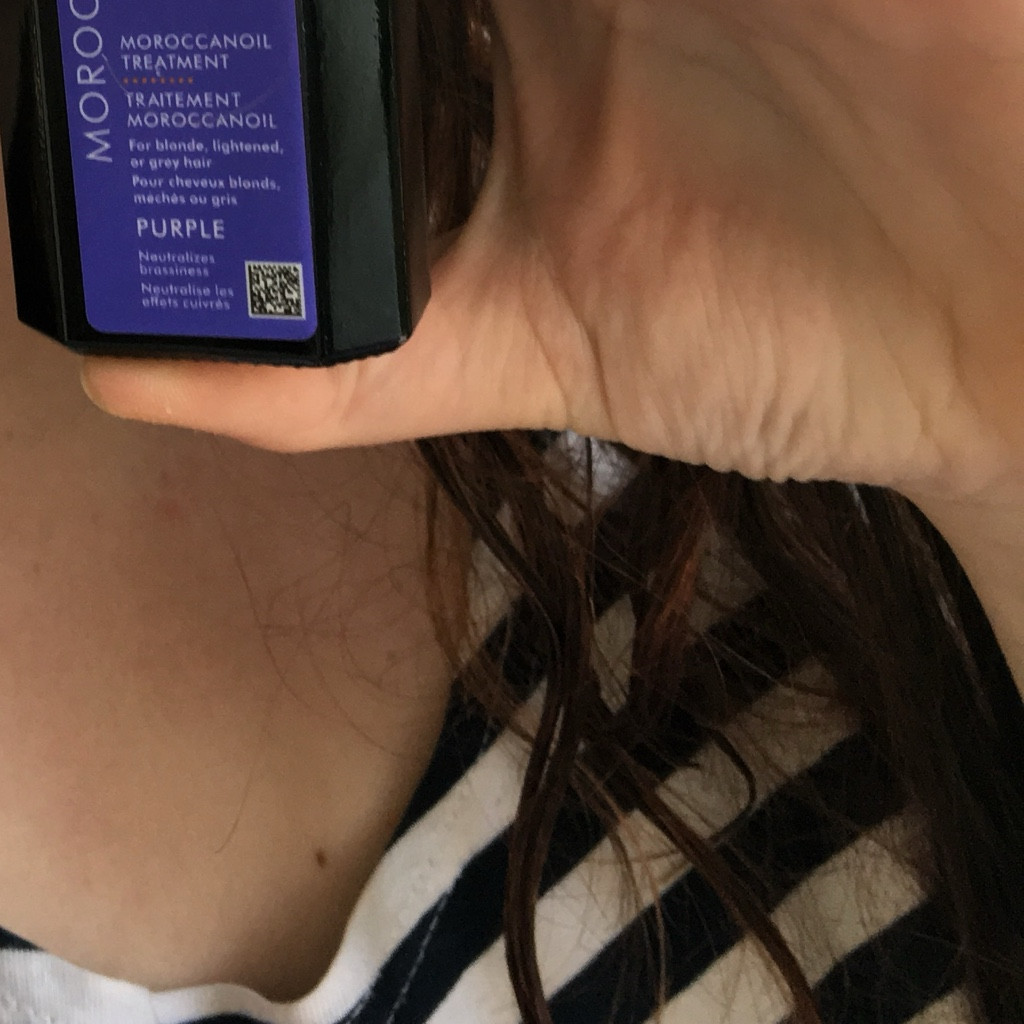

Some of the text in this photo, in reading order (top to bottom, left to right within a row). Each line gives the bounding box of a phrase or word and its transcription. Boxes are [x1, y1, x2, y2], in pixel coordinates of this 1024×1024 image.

[120, 33, 272, 51] MOROCCANOIL
[121, 53, 229, 71] TREATMENT
[126, 91, 241, 109] TRAITEMENT
[126, 111, 277, 129] MOROCCANOIL
[129, 138, 284, 156] For blonde, lightened,
[130, 155, 212, 171] or grey hair
[132, 174, 163, 188] Pour
[168, 174, 225, 189] cheveux
[189, 194, 207, 205] ou
[211, 193, 237, 208] gris
[136, 217, 225, 239] PURPLE
[138, 249, 215, 264] Neutralizes
[139, 262, 209, 276] brassiness
[141, 282, 211, 297] Neutralise
